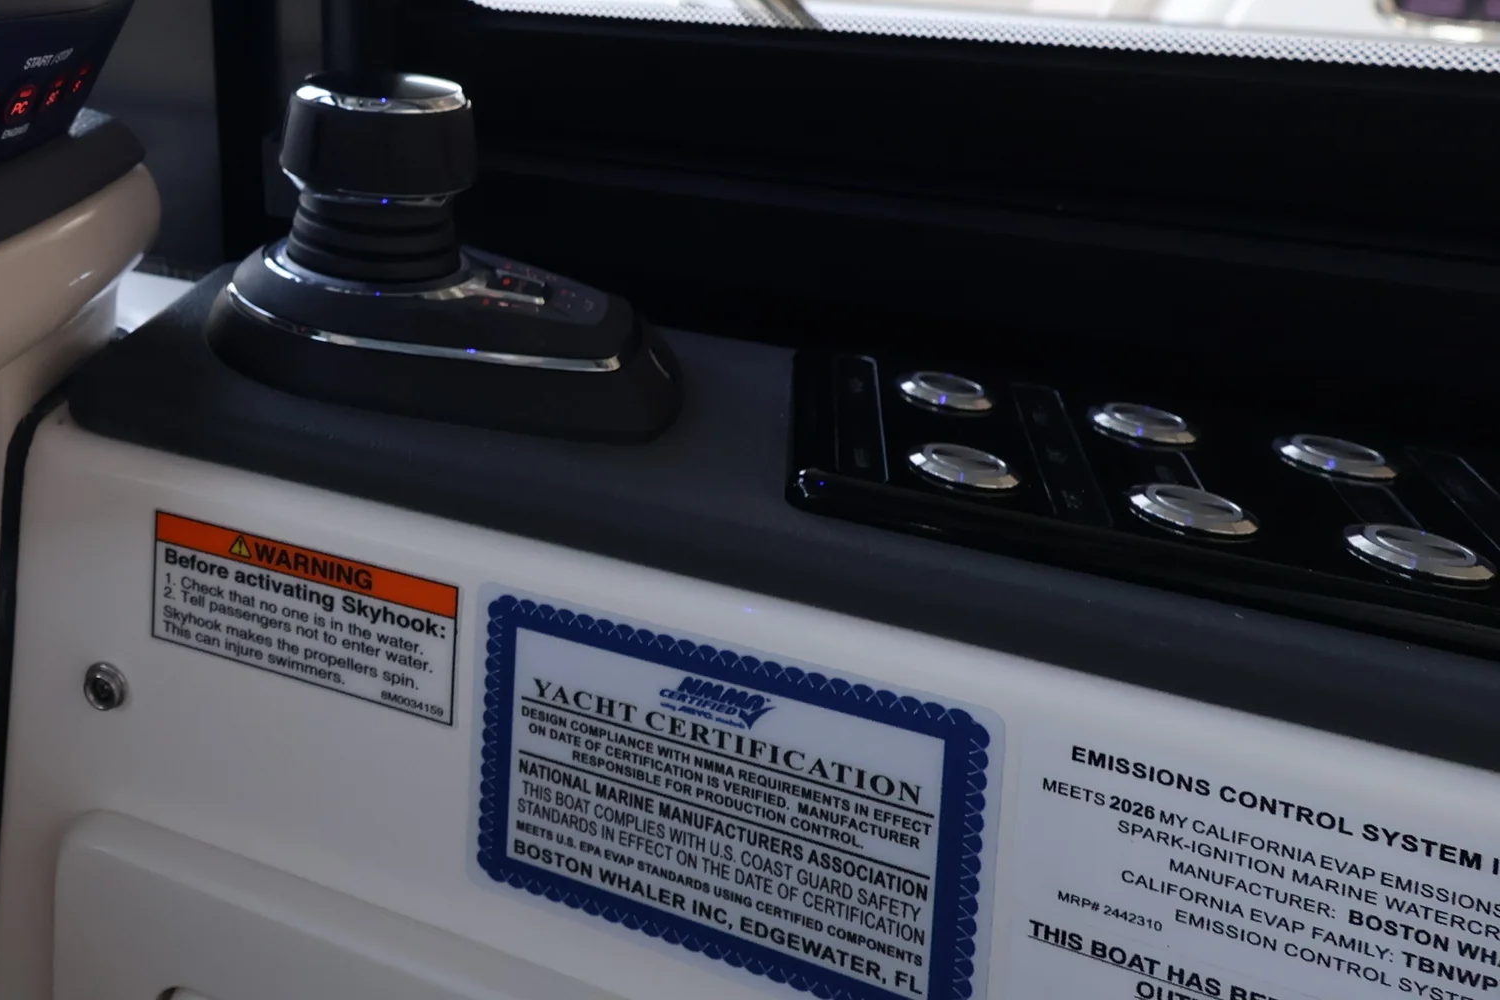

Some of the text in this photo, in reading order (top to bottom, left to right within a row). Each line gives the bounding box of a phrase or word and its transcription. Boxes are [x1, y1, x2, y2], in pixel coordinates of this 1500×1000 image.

[165, 548, 446, 639] Before activating Skyhook:
[255, 542, 373, 590] WARNING
[163, 586, 433, 673] 2. Tell passengers not to enter water.
[163, 604, 419, 690] Skyhook makes the propellers spin.
[163, 619, 345, 685] This can injure swimmers.
[165, 573, 424, 655] 1. Check that no one is in the water.
[381, 690, 444, 717] 8M0034159
[659, 688, 738, 716] CERTIFIED
[677, 676, 766, 712] NMMA
[521, 705, 932, 836] DESIGN COMPLIANCE WITH NMMA REQUIREMENTS IN EFFECT
[528, 722, 921, 849] ON DATE OF CERTIFICATION IS VERIFIED. MANUFACTURER
[533, 677, 922, 806] YACHT CERTIFICATION
[518, 759, 928, 901] NATIONAL MARINE MANUFACTURERS ASSOCIATION
[572, 750, 864, 849] RESPONSIBLE FOR PRODUCTION CONTROL.
[1071, 745, 1211, 796] EMISSIONS
[1219, 785, 1354, 836] CONTROL
[1362, 823, 1482, 871] SYSTEM
[516, 820, 923, 967] MEETS U.S. EPA EVAP STANDARDS USING CERTIFIED COMPONENTS
[517, 797, 925, 946] STANDARDS IN EFFECT ON THE DATE OF CERTIFICATION
[522, 780, 921, 922] THIS BOAT COMPLIES WITH U.S. COAST GUARD SAFETY
[1042, 777, 1500, 918] MEETS 2026 MY CALIFORNIA EVAP EMISSIONS
[1118, 819, 1285, 879] SPARK-IGNITION
[1292, 869, 1378, 906] MARINE
[514, 839, 922, 995] BOSTON WHALER INC, EDGEWATER, FL
[1057, 889, 1163, 932] MRP# 2442310
[1121, 869, 1244, 918] CALIFORNIA
[1250, 907, 1305, 934] EVAP
[1311, 926, 1394, 963] FAMILY:
[1169, 858, 1500, 968] MANUFACTURER: BOSTON WH
[1175, 908, 1277, 952] EMISSION
[1284, 942, 1391, 987] CONTROL
[1029, 918, 1083, 952] THIS
[1090, 939, 1161, 975] BOAT
[1167, 964, 1221, 997] HAS
